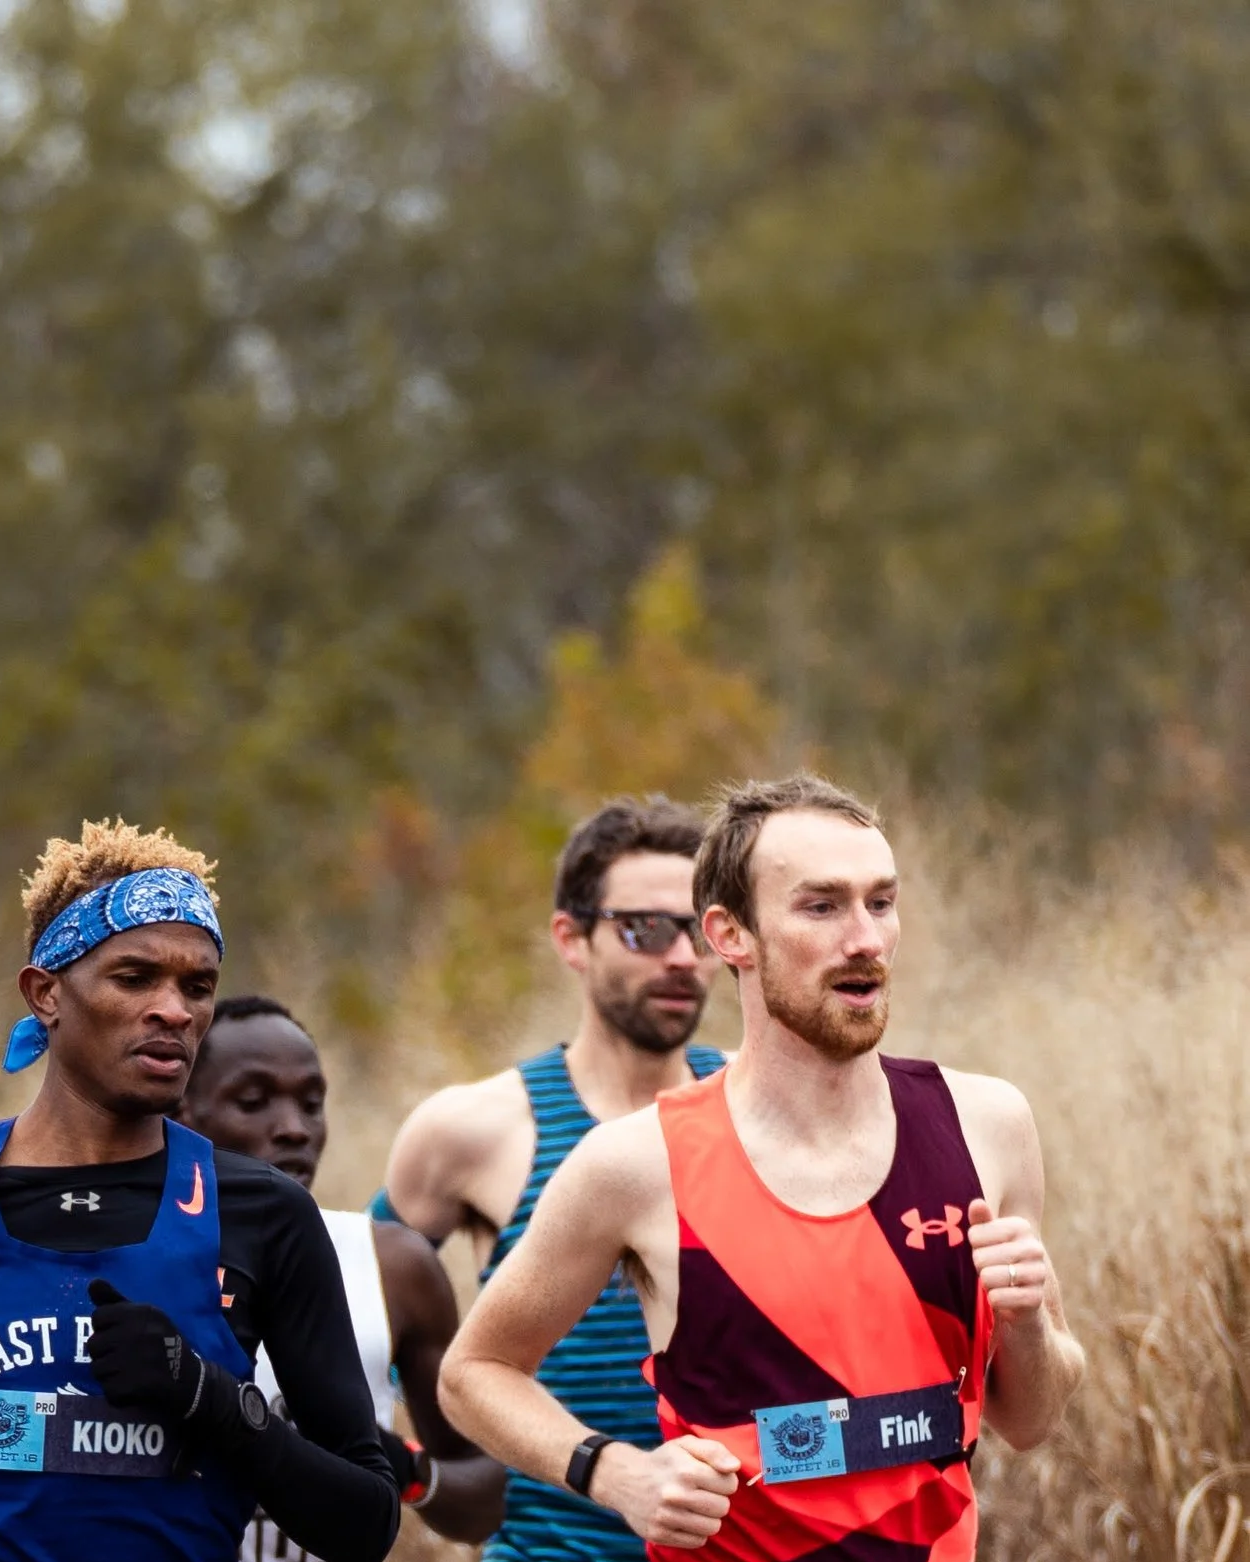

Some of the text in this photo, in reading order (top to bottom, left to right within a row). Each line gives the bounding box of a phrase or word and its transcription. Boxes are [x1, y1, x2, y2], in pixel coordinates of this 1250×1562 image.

[35, 1402, 56, 1413] PRO
[829, 1408, 848, 1419] PRO
[880, 1410, 933, 1448] Fink
[72, 1420, 164, 1456] KIOKO
[23, 1453, 38, 1463] 16
[771, 1459, 840, 1475] SWEET 16
